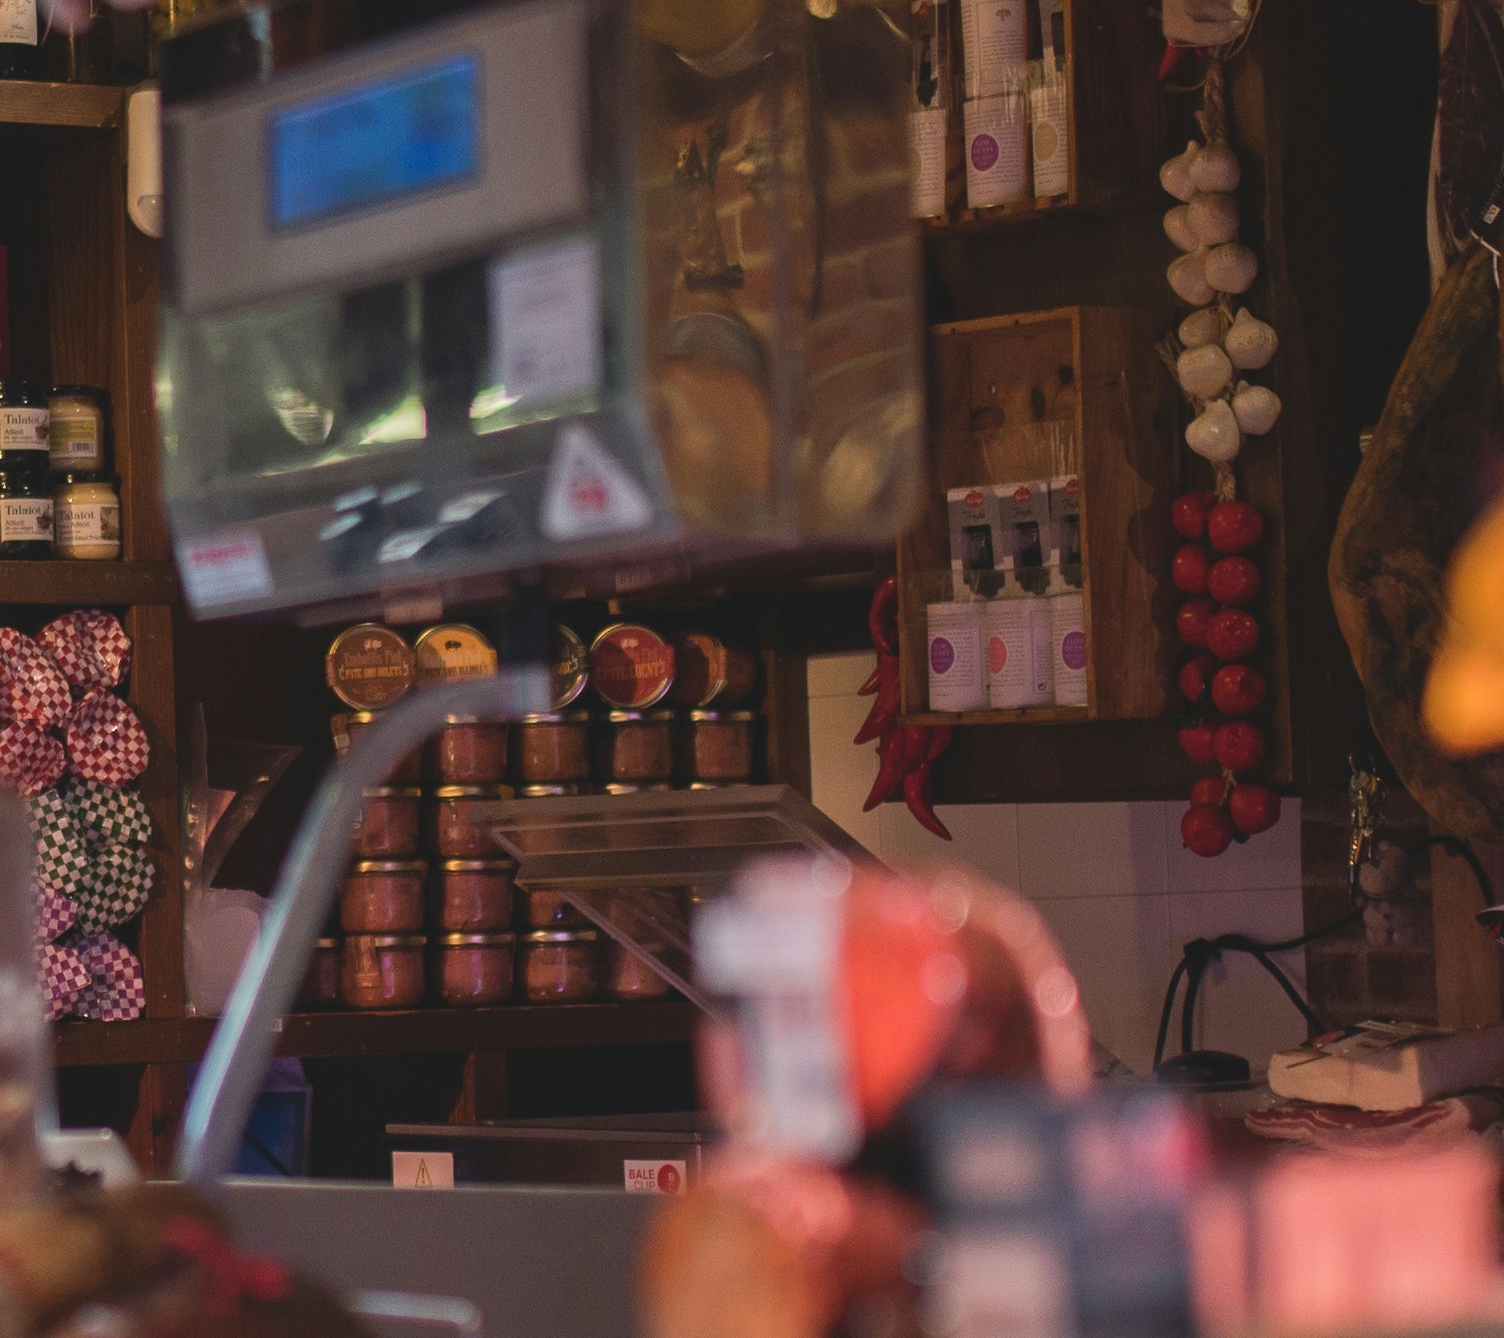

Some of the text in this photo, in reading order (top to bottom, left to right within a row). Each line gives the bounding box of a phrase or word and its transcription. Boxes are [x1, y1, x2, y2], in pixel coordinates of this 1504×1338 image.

[4, 414, 41, 425] Talaiot
[4, 505, 43, 516] Talaiot
[629, 1169, 655, 1179] BALE
[634, 1181, 655, 1190] CLIP
